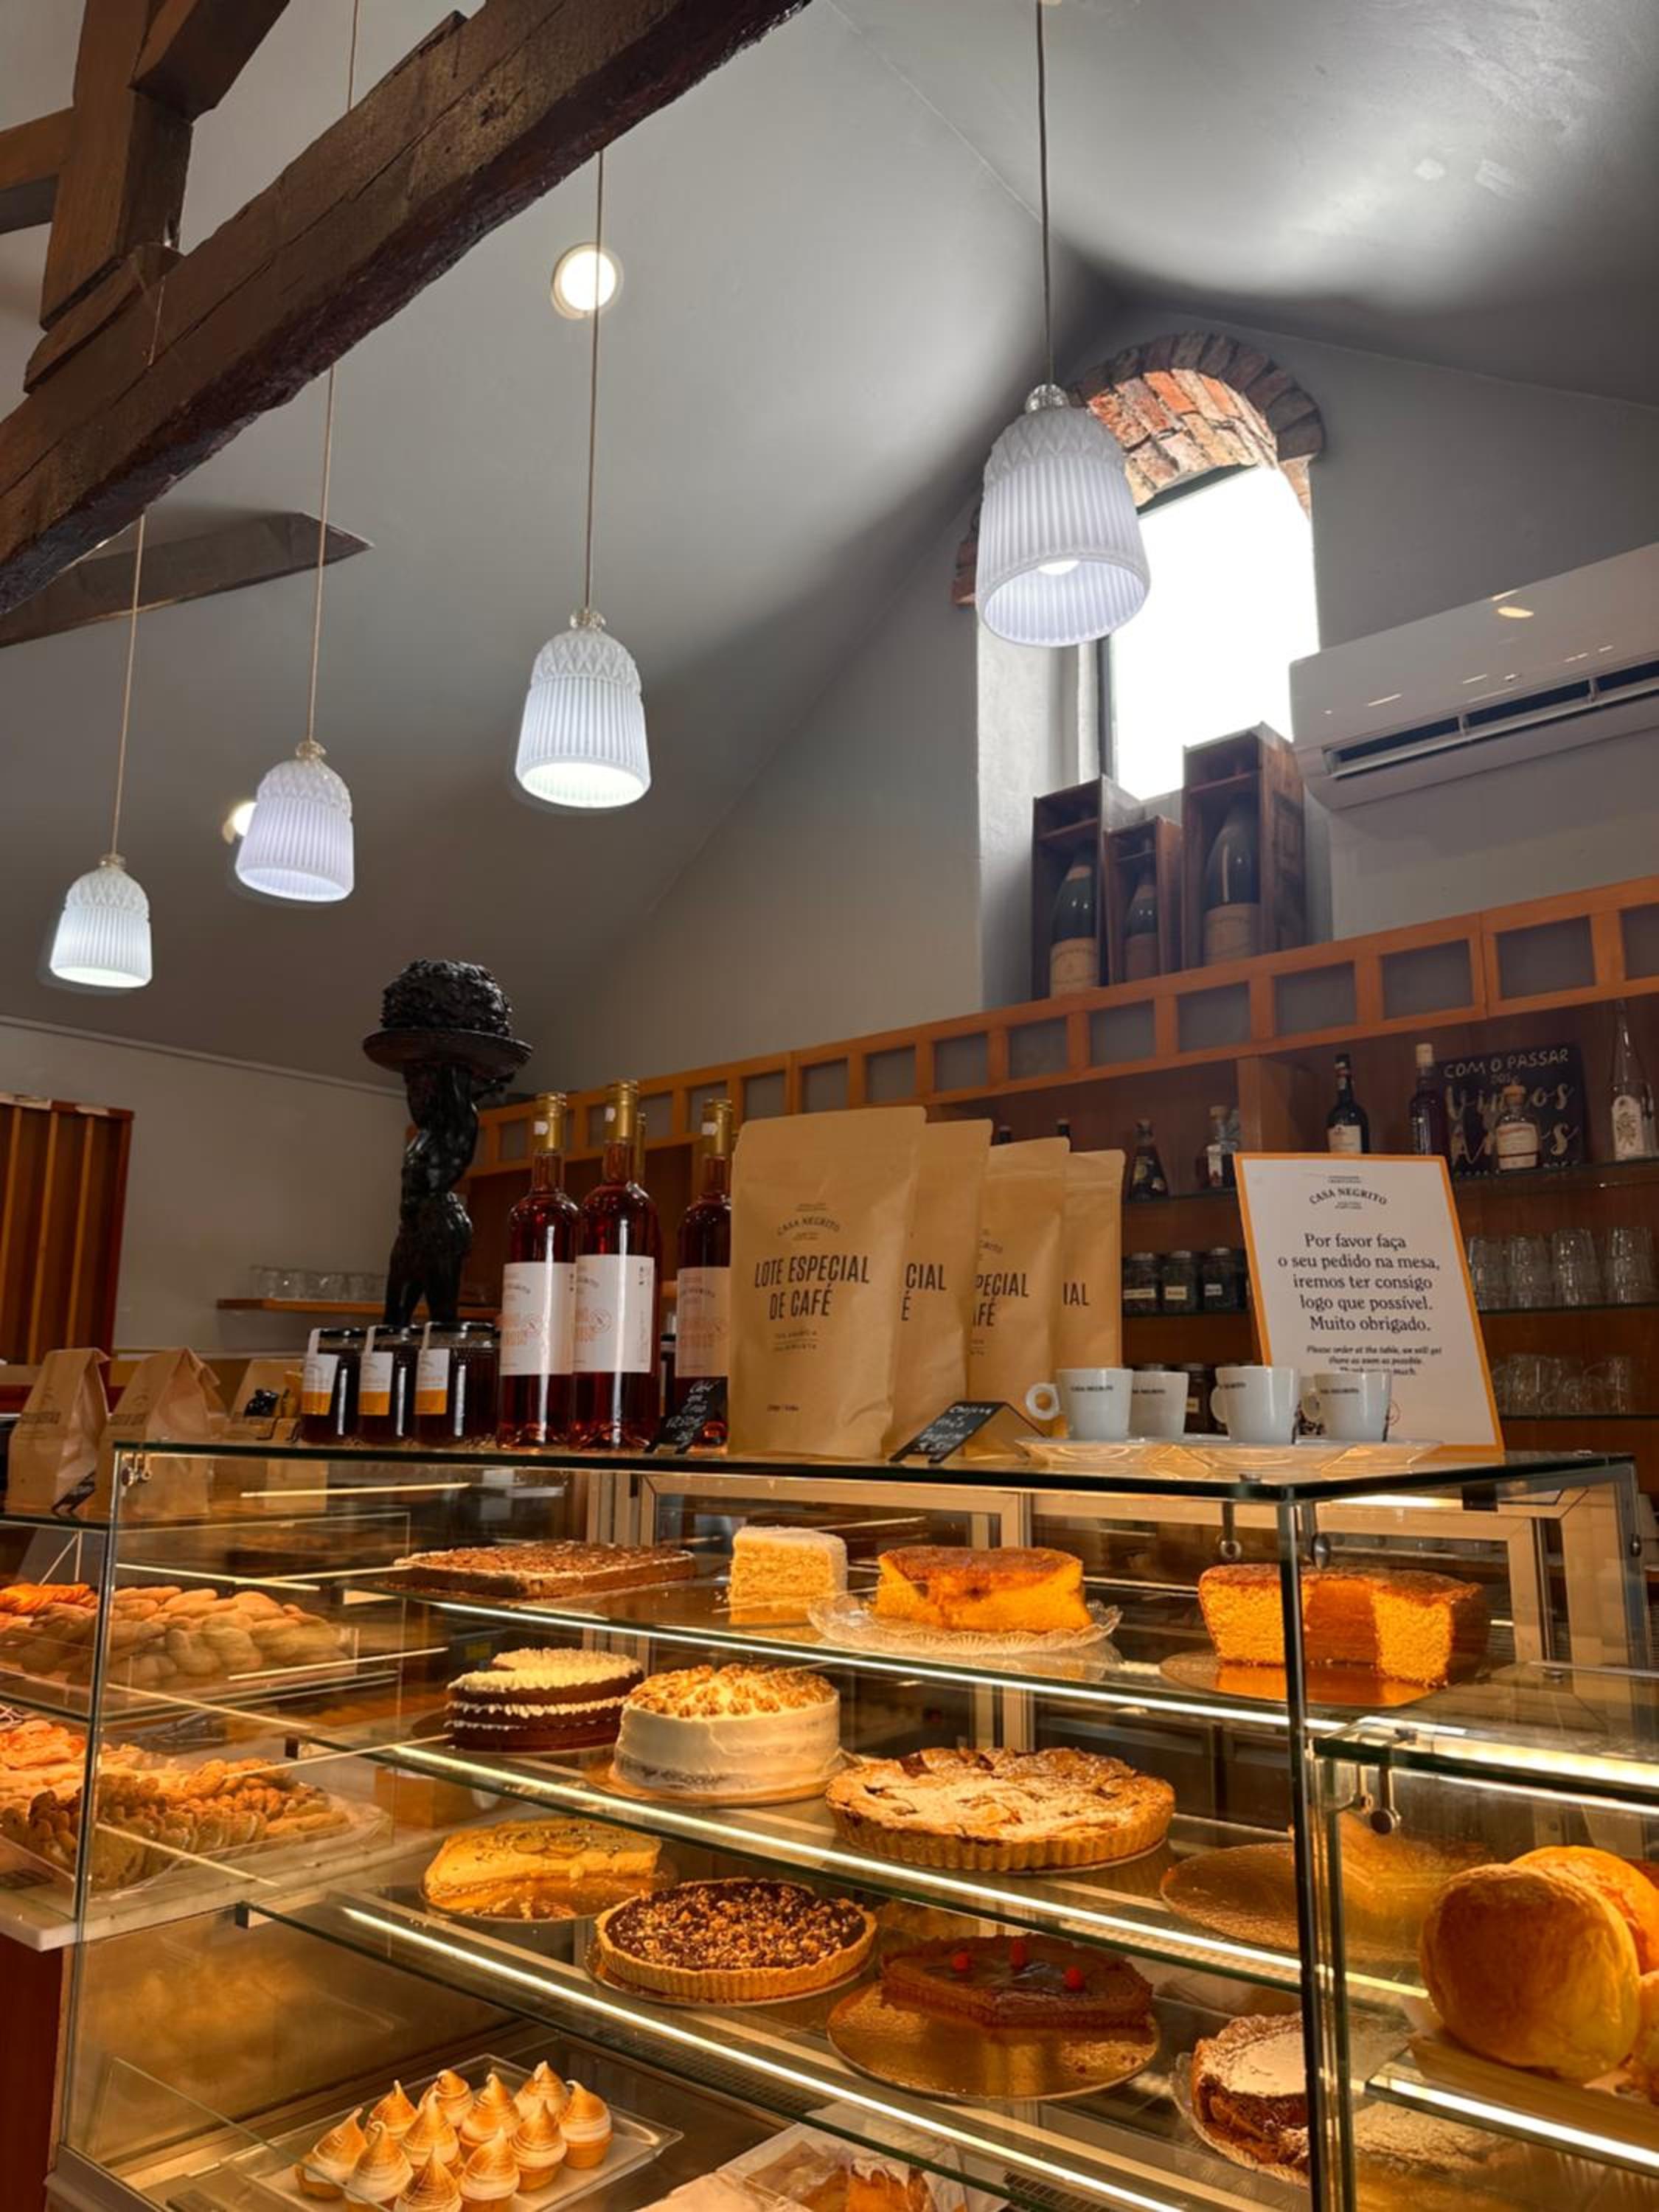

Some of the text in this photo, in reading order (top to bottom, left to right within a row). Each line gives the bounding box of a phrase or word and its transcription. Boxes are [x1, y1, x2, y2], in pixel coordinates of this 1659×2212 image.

[1443, 1048, 1569, 1079] COM O PASSAR
[1309, 1189, 1336, 1205] CASA
[1337, 1187, 1388, 1206] NEGRITO
[1304, 1233, 1407, 1251] Por favor faça
[1278, 1253, 1440, 1270] o seu pedido na mesa,
[754, 1254, 870, 1289] LOTE ESPECIAL
[905, 1262, 947, 1290] CIAL
[975, 1272, 1029, 1298] PECIAL
[1293, 1273, 1433, 1292] iremos ter consigo
[769, 1283, 833, 1321] DE CAFÉ
[1300, 1294, 1433, 1312] logo que possível.
[1309, 1315, 1431, 1333] Muito obrigado.
[1307, 1345, 1331, 1354] Please
[1332, 1345, 1354, 1354] order
